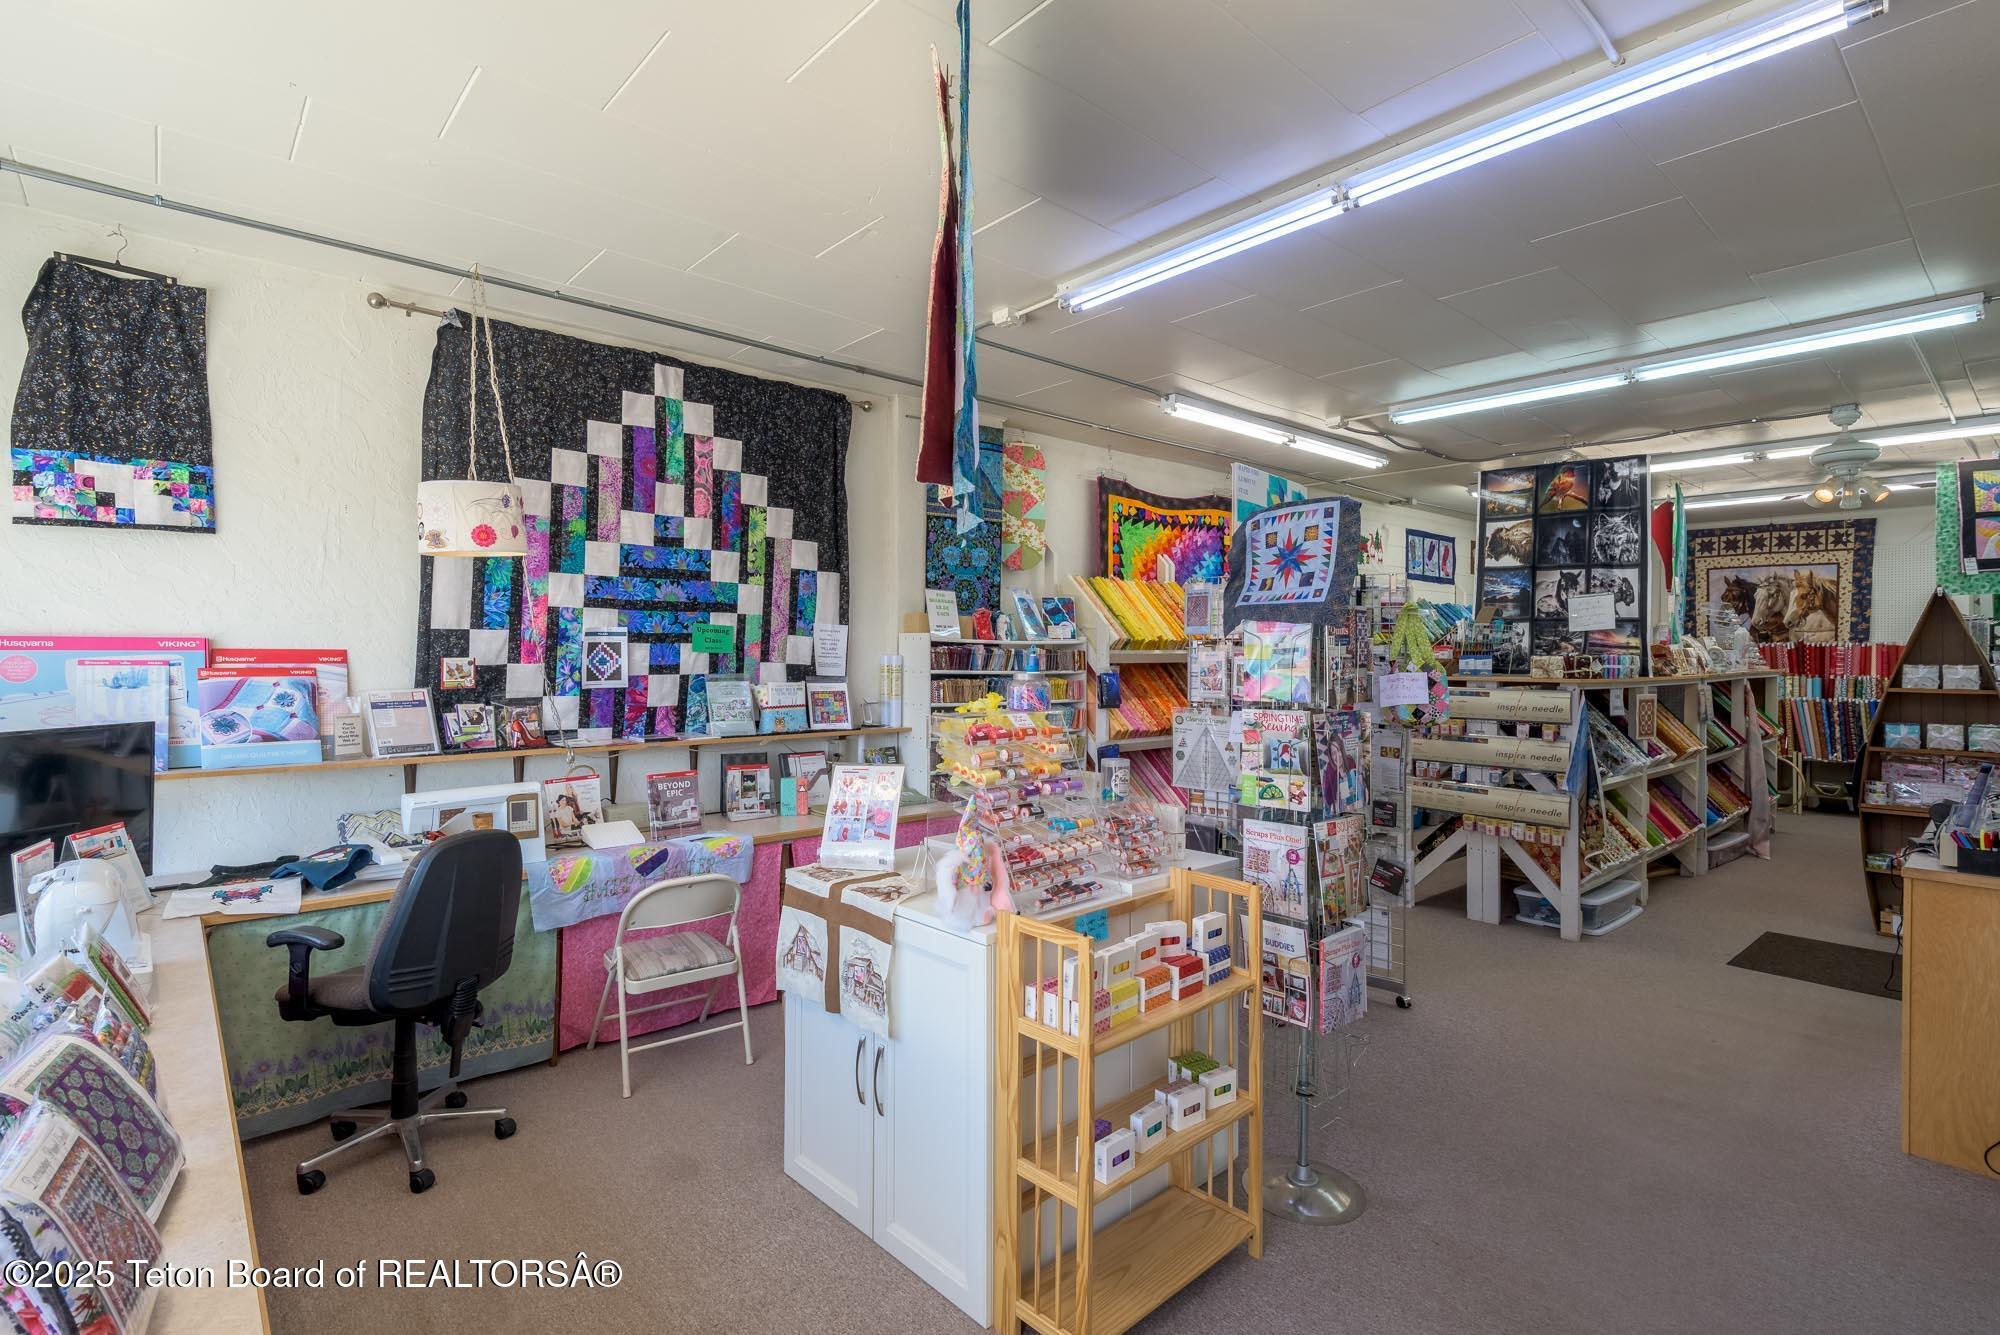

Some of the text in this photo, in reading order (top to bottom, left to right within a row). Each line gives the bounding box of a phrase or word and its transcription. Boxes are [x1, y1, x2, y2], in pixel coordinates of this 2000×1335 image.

[697, 626, 730, 635] Upcoming
[0, 639, 54, 648] Husqvarna
[1497, 703, 1564, 714] inspira needle
[1253, 711, 1304, 724] SPRINGTIME
[1261, 720, 1297, 738] Sewing
[1495, 751, 1562, 763] inspira needle
[657, 780, 691, 791] BEYOND
[666, 788, 683, 797] EPIC
[1495, 802, 1562, 817] inspira needle
[1245, 828, 1269, 839] Scraps
[1264, 937, 1295, 952] BUDDIES
